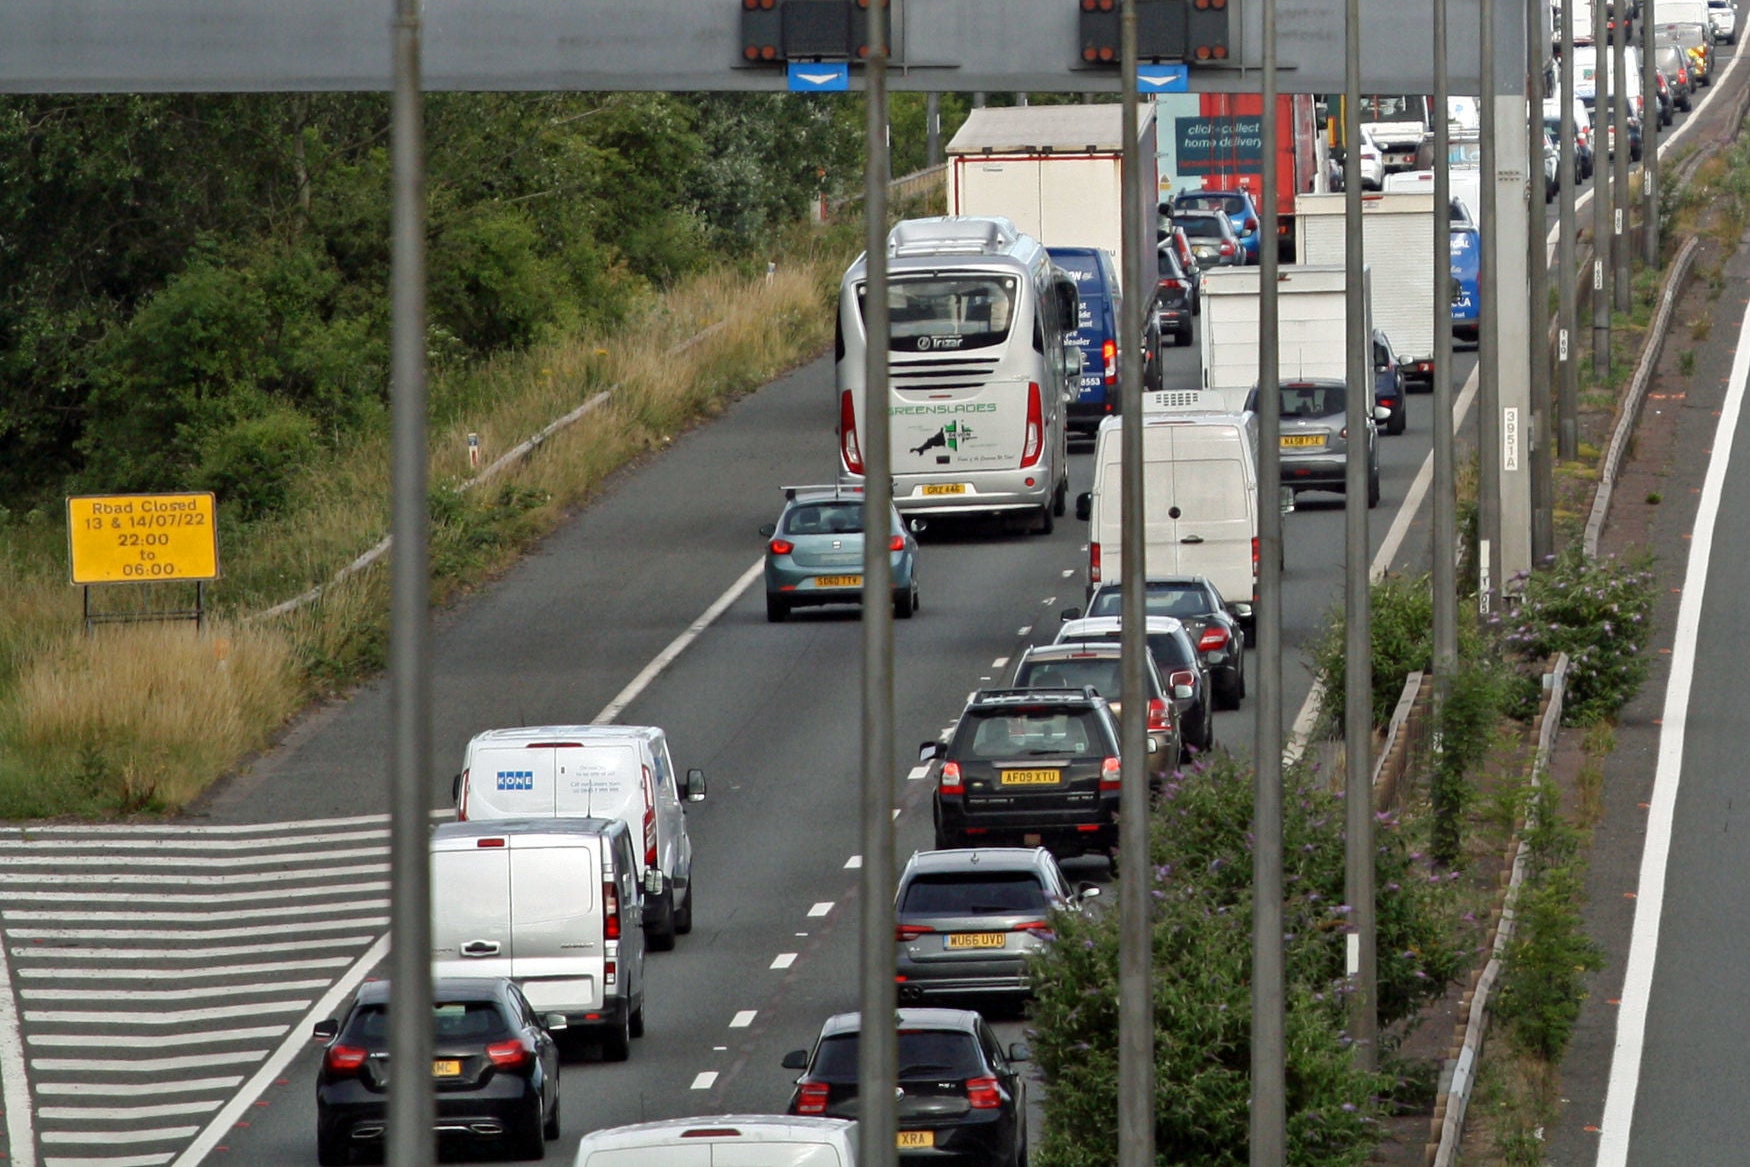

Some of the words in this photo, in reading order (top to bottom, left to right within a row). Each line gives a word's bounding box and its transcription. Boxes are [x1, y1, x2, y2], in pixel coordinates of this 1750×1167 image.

[1506, 410, 1516, 467] 3951A
[92, 501, 133, 515] Road
[141, 499, 197, 513] Closed
[85, 517, 103, 530] 13
[111, 517, 122, 529] &
[129, 512, 206, 529] 14/07/22
[117, 533, 169, 547] 22:00
[139, 549, 156, 561] to
[122, 562, 175, 576] 06:00
[498, 776, 532, 785] KONE
[1006, 772, 1032, 783] AF09
[1035, 771, 1056, 782] XTU
[901, 1133, 926, 1145] XRA
